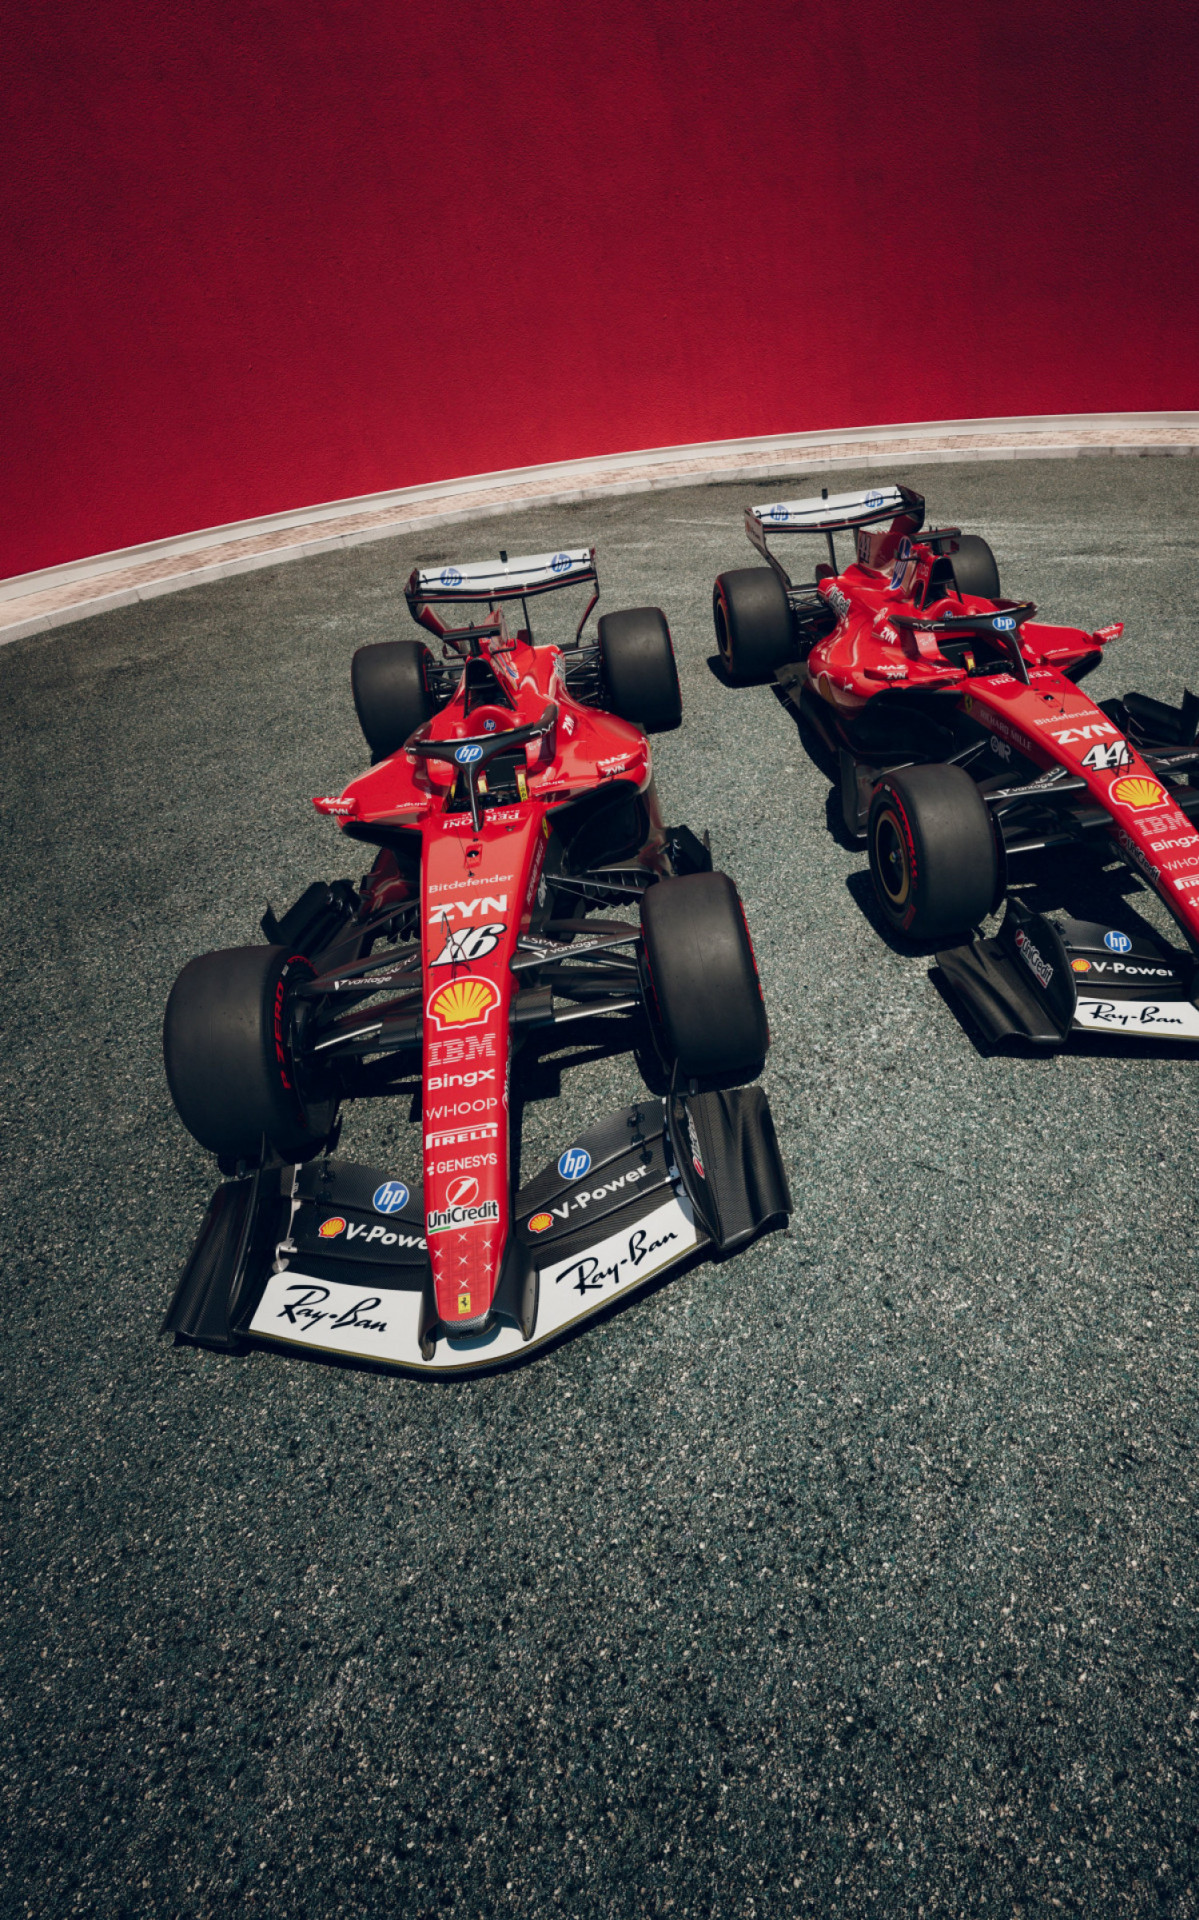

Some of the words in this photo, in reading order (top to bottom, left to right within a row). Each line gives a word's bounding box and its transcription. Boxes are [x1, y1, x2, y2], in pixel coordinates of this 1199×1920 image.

[551, 554, 572, 573] hp
[440, 568, 463, 587] hp
[993, 616, 1016, 631] hp
[880, 626, 898, 645] ZYN
[484, 719, 496, 731] hp
[1033, 709, 1099, 726] Bitdefender
[1051, 722, 1118, 745] ZYN
[455, 744, 483, 763] hp
[1081, 740, 1133, 772] 44
[1012, 782, 1054, 792] vantage
[1133, 811, 1192, 836] IBM
[1162, 857, 1199, 871] WHO
[428, 874, 514, 894] Bitdefender
[1173, 873, 1199, 891] PIR
[428, 894, 508, 925] ZYN
[428, 922, 508, 969] 16
[550, 940, 599, 954] vantage
[1104, 930, 1132, 953] hp
[1021, 937, 1054, 985] UniCredit
[1092, 961, 1175, 977] V-Power
[347, 975, 392, 986] vantage
[1078, 1001, 1183, 1025] Ray-Ban
[428, 1032, 496, 1068] IBM
[426, 1097, 498, 1121] WHOOP
[425, 1122, 499, 1150] PIRELLI
[436, 1152, 498, 1174] GENESYS
[558, 1148, 591, 1180] hp
[373, 1181, 409, 1213] hp
[551, 1165, 647, 1219] V-Power
[427, 1200, 499, 1229] UniCredit
[346, 1222, 429, 1250] V-Powe
[555, 1229, 678, 1296] Ray-Ban
[276, 1284, 388, 1332] Ray-Ban
